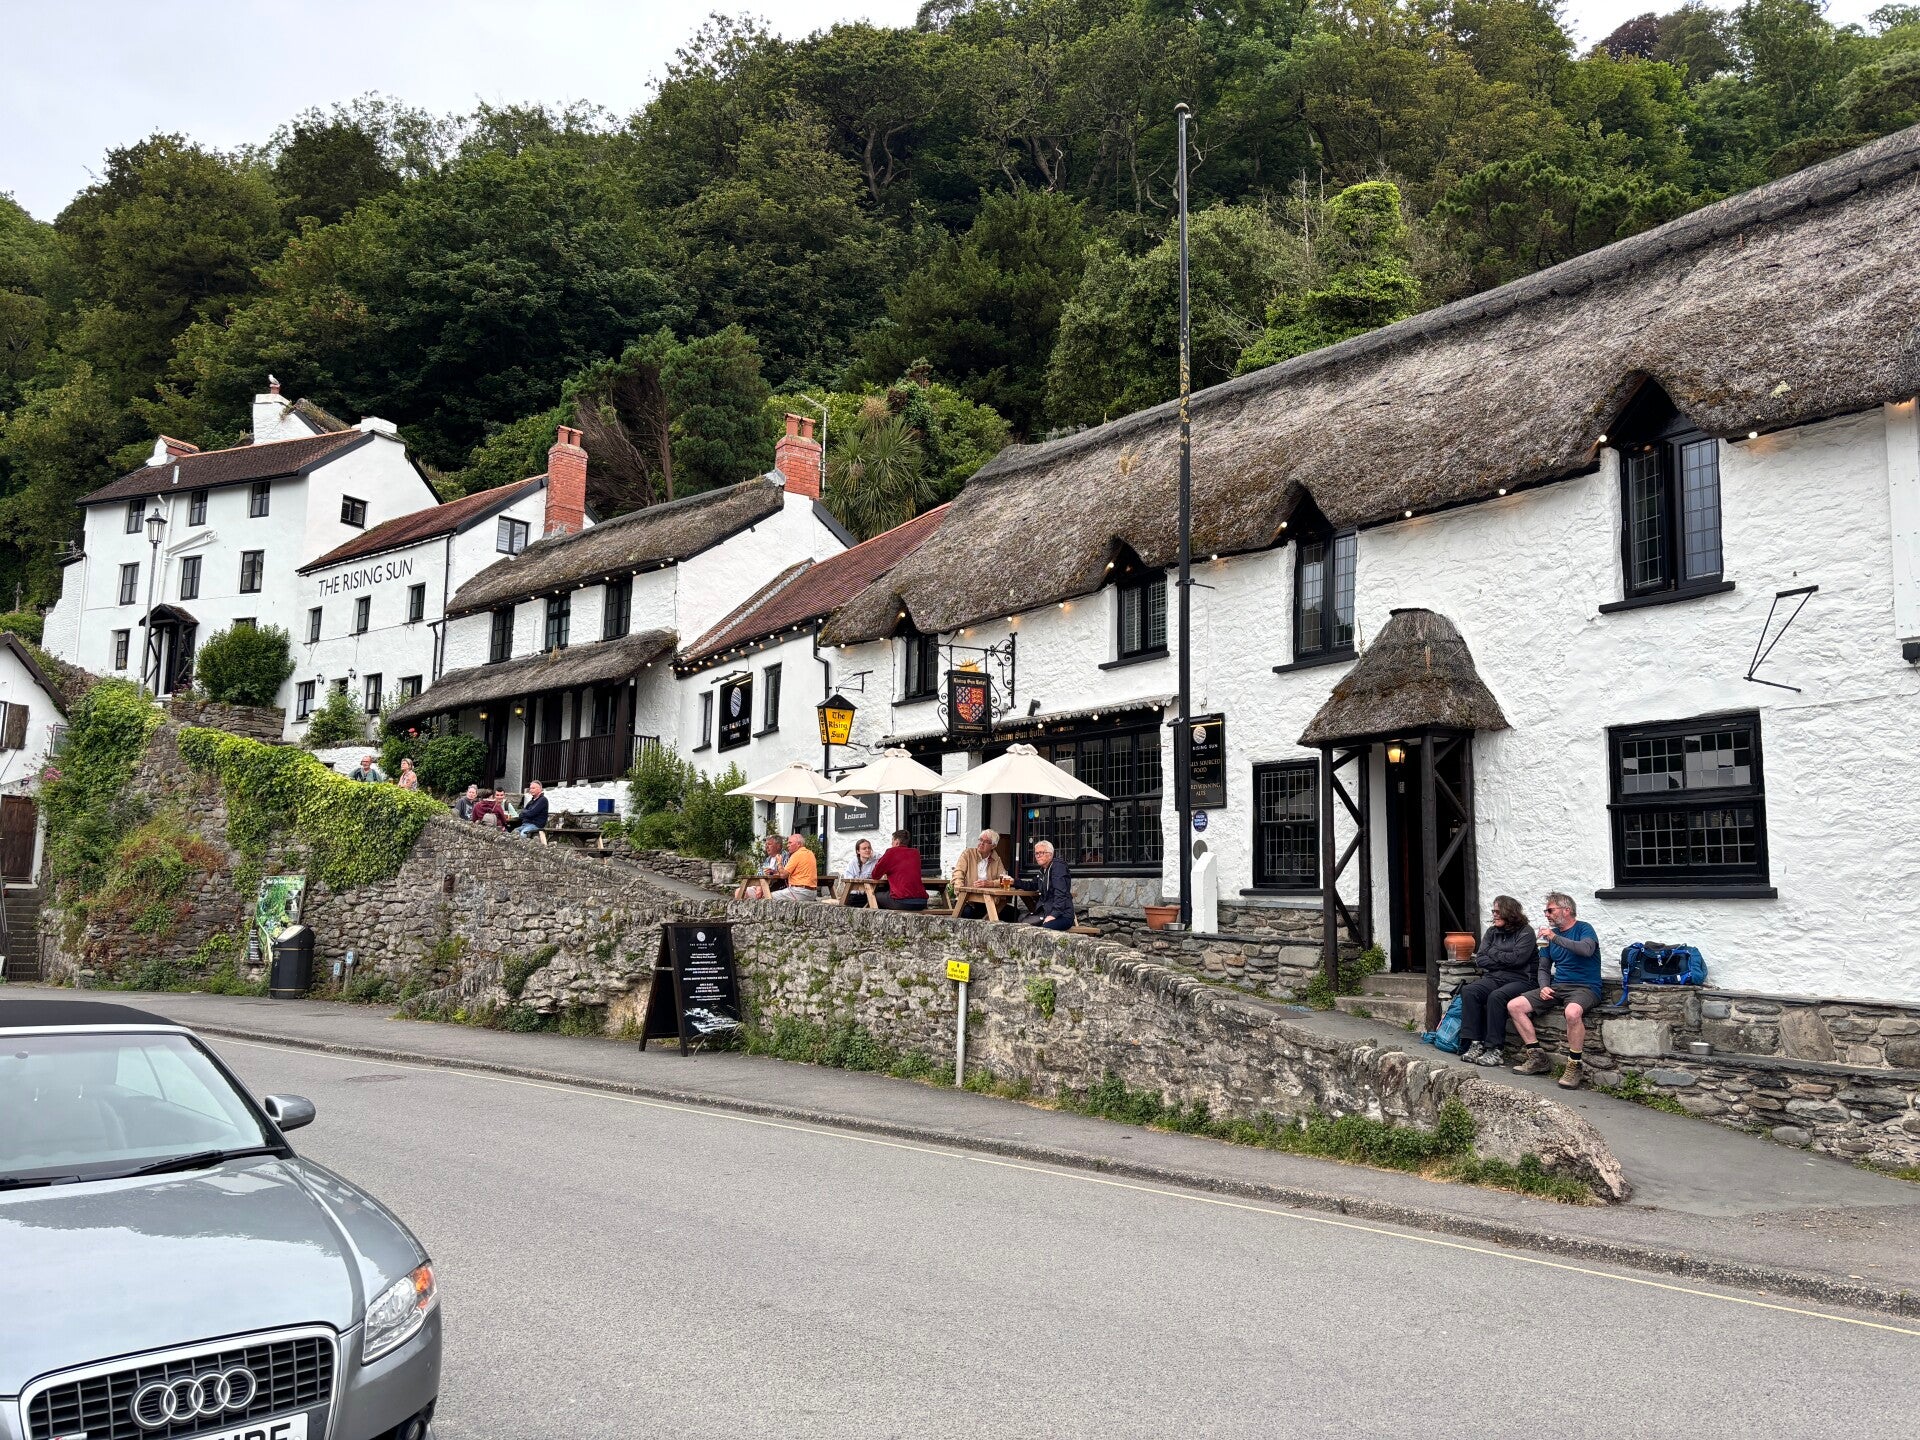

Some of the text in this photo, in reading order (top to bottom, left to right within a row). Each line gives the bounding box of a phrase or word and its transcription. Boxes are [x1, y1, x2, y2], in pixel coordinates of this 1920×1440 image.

[318, 557, 413, 598] THE RISING SUN
[832, 711, 846, 720] The
[828, 720, 848, 731] Rising
[831, 730, 845, 739] Sun
